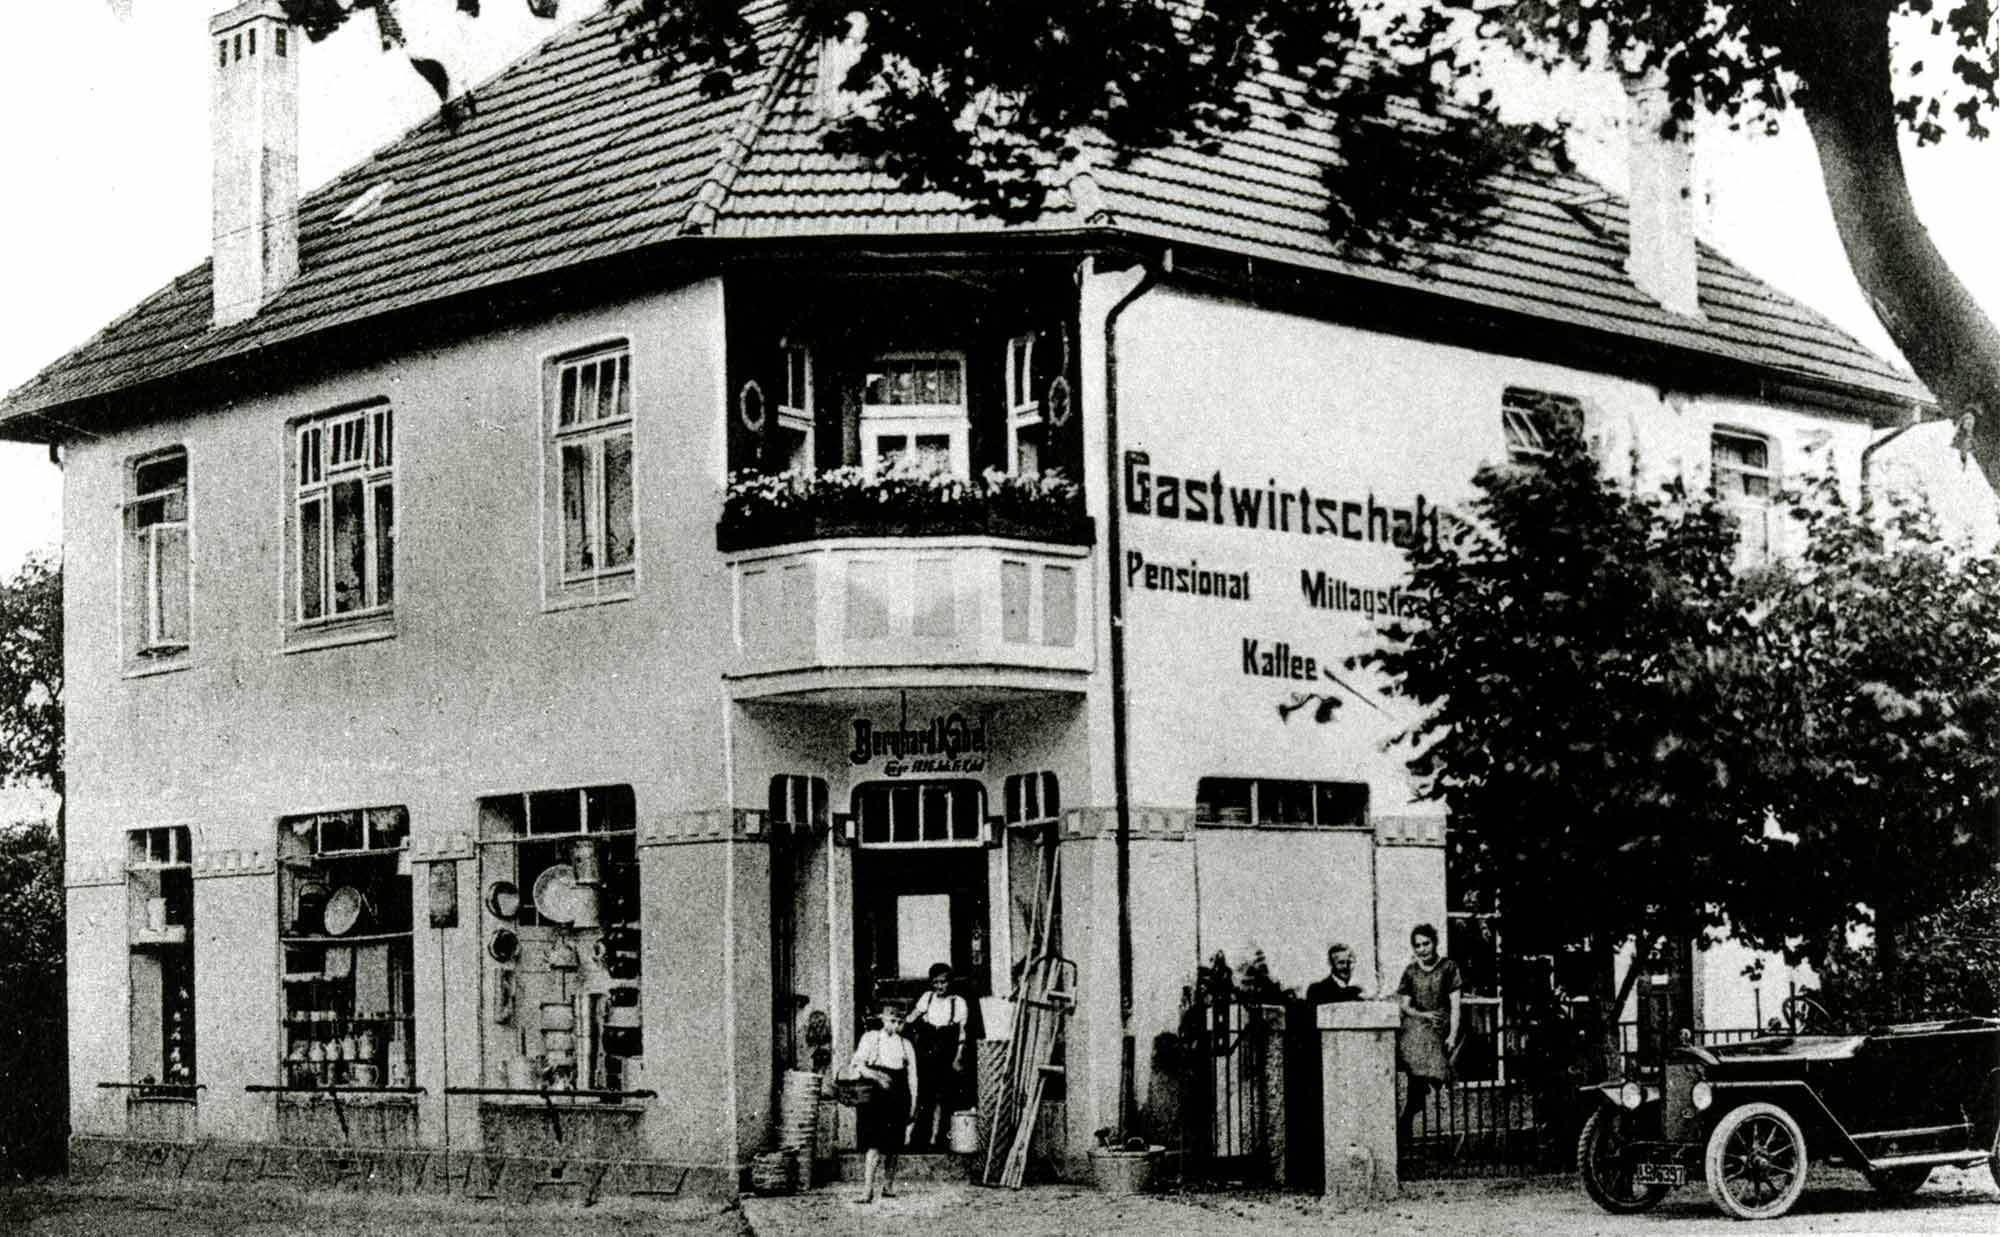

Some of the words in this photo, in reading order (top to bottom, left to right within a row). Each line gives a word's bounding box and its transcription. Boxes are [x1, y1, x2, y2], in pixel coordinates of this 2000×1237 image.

[1124, 450, 1439, 551] Gastwirtschaft
[1127, 551, 1250, 601] Pensionat
[1242, 638, 1318, 681] Kaffee
